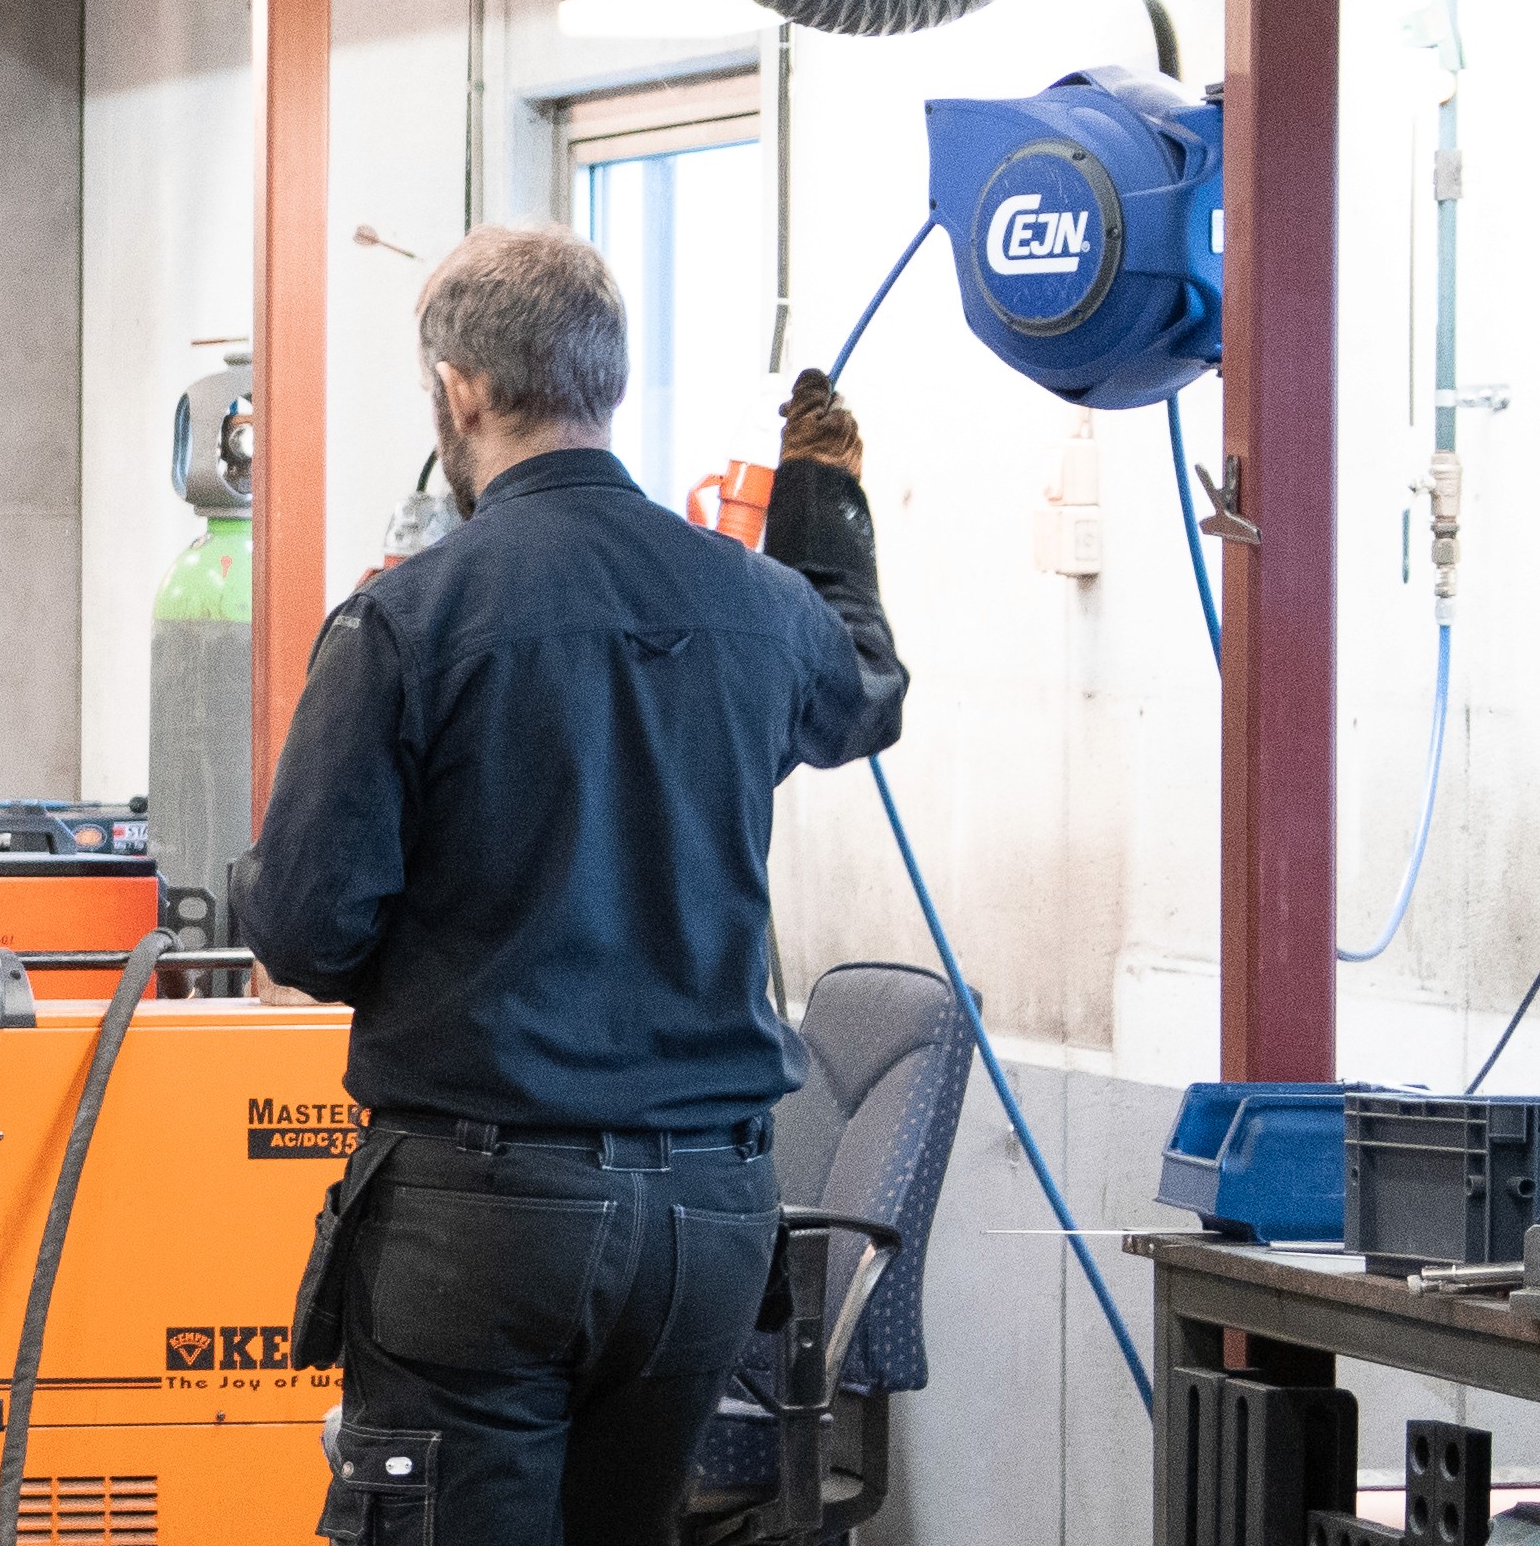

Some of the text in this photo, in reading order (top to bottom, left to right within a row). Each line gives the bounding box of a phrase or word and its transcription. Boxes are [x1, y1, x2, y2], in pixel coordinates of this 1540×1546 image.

[986, 192, 1089, 275] CEJN
[270, 1132, 329, 1147] AC/DC
[166, 1377, 208, 1389] The
[219, 1376, 260, 1391] Joy
[274, 1375, 298, 1388] of
